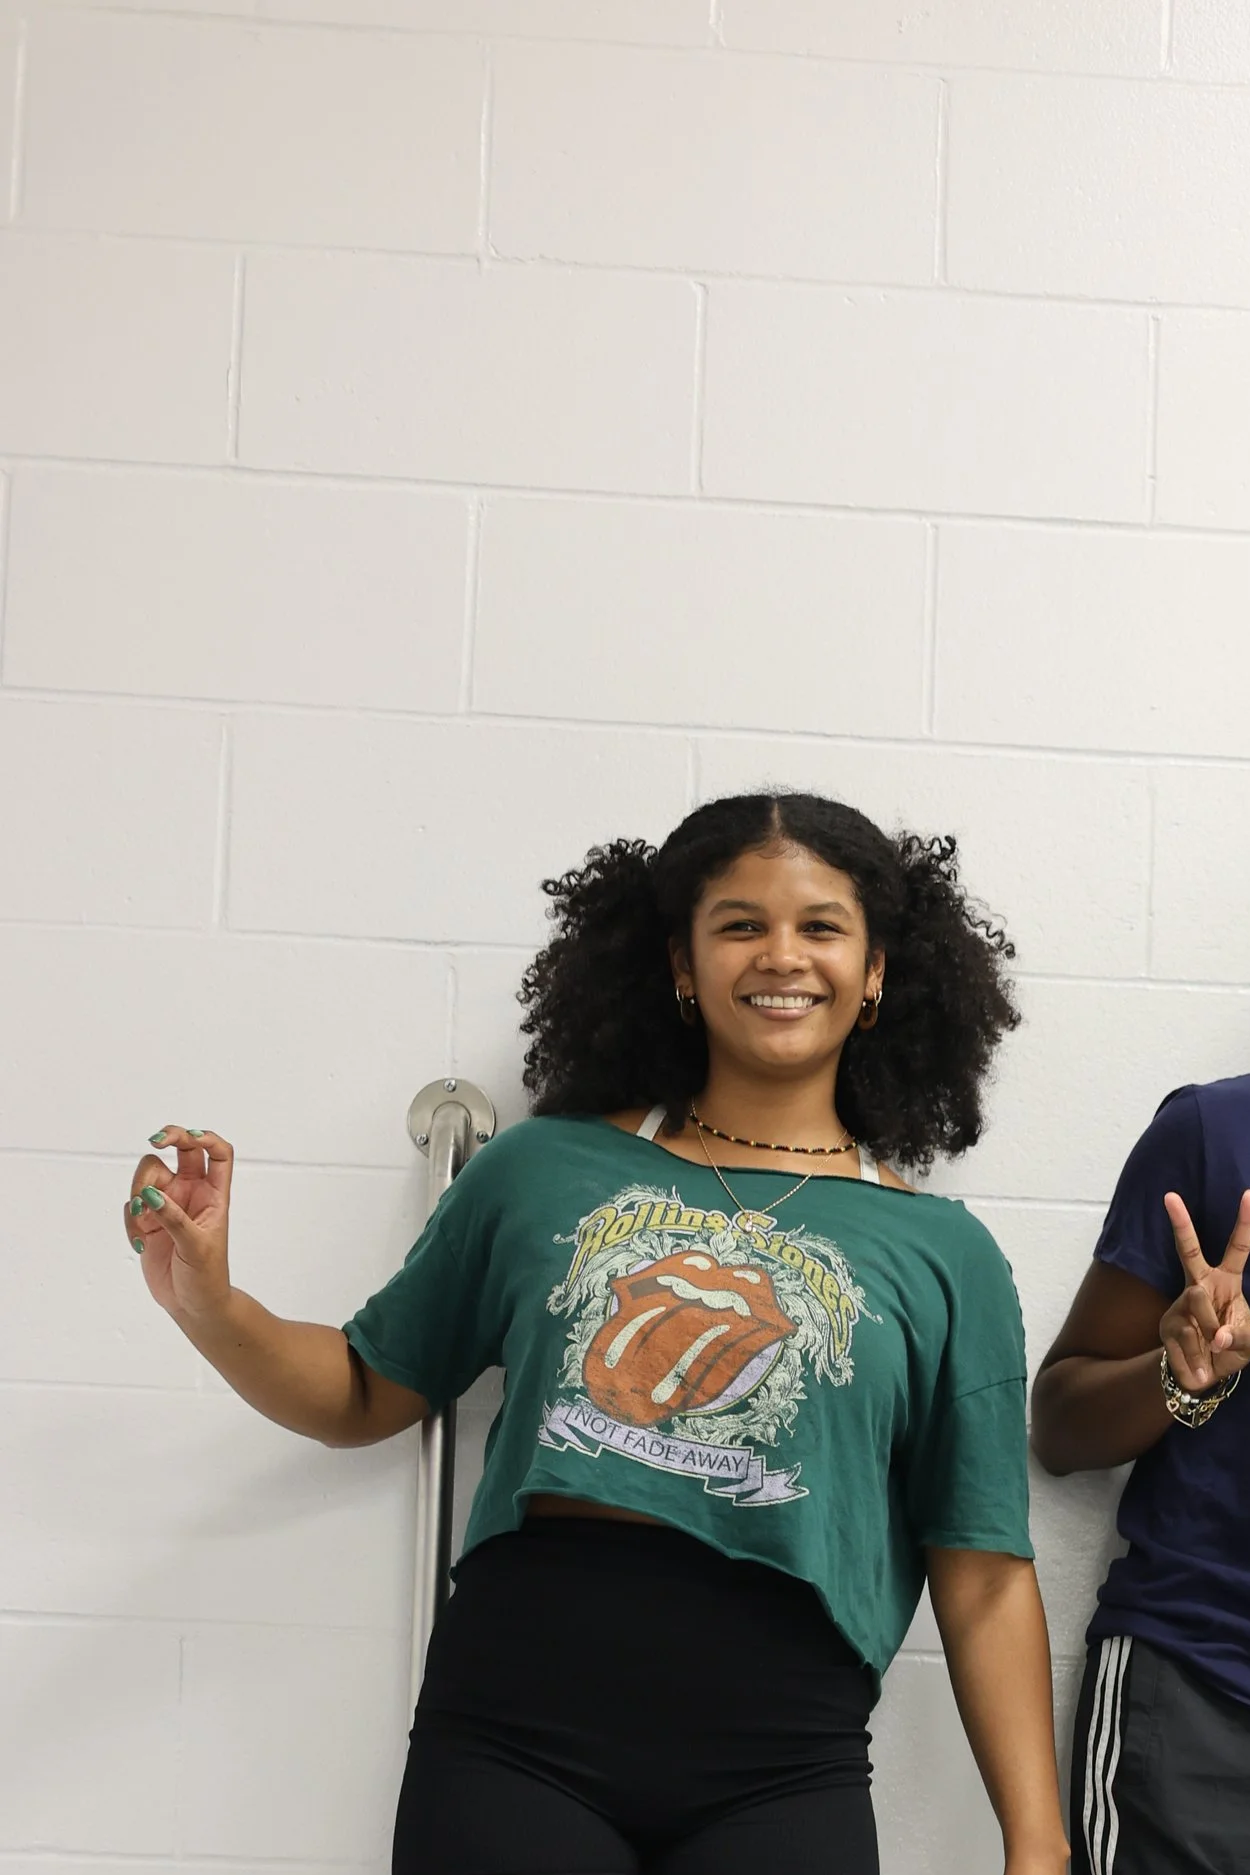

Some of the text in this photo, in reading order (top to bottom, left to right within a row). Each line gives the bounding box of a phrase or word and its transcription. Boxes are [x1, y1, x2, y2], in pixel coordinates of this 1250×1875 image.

[733, 1213, 855, 1356] Stones
[574, 1406, 744, 1473] NOT FADE AWAY
